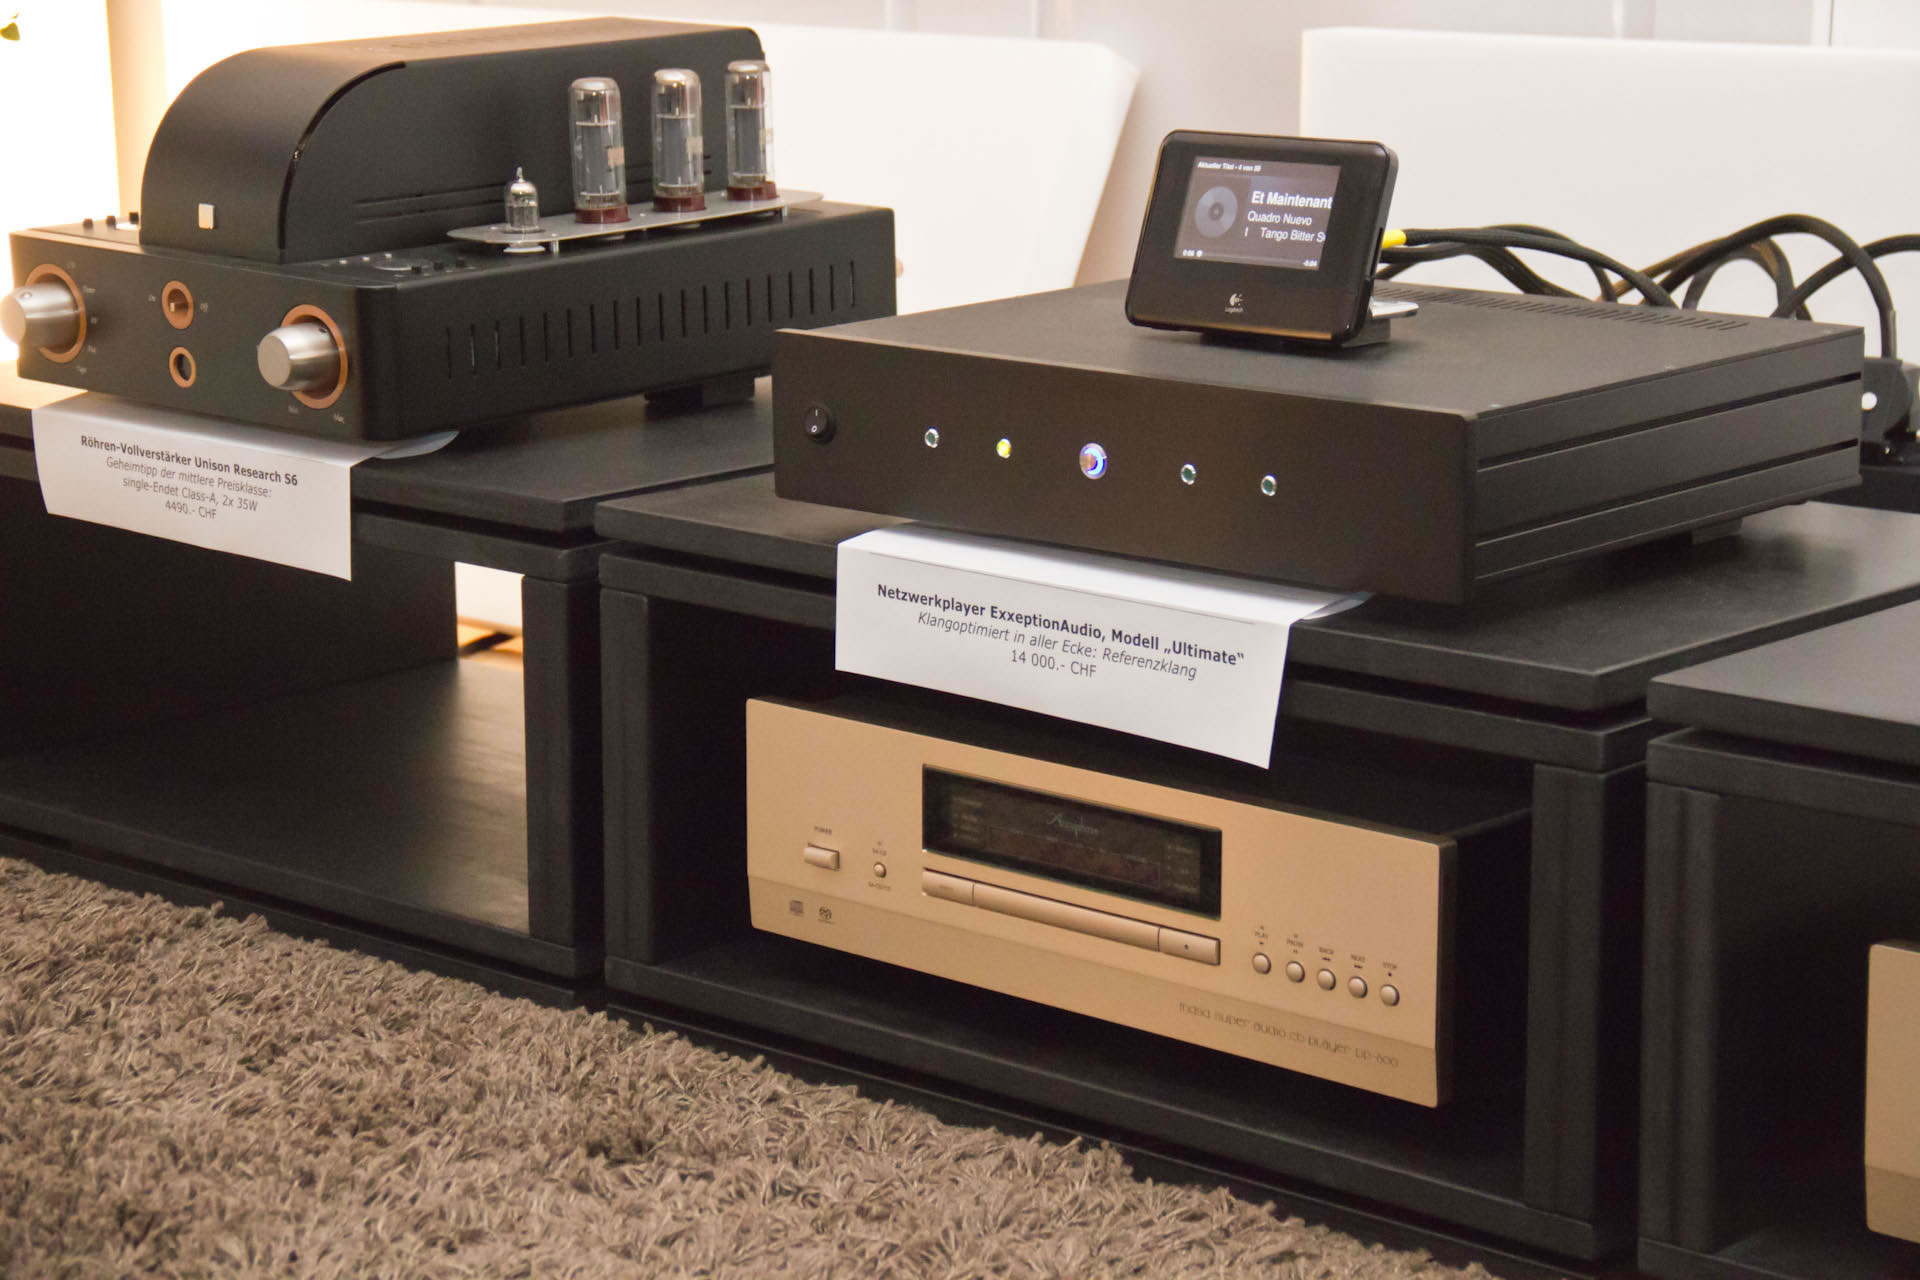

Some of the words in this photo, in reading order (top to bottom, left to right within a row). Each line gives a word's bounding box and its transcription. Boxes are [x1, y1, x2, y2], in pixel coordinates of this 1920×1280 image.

[1251, 190, 1265, 204] Et
[1266, 191, 1333, 209] Maintenant
[1247, 210, 1281, 224] Quadro
[1283, 213, 1312, 226] Nuevo
[1260, 226, 1289, 242] Tango
[1290, 228, 1315, 242] Bitter
[80, 435, 192, 466] Röhren-Vollverstärker
[194, 456, 231, 473] Unison
[233, 463, 282, 483] Research
[284, 472, 298, 486] S6
[106, 456, 158, 478] Geheimtipp
[160, 467, 176, 479] der
[178, 472, 215, 487] mittlere
[217, 477, 272, 498] Preisklasse:
[122, 477, 179, 497] single-Endet
[182, 487, 219, 506] Class-A,
[222, 494, 234, 507] 2x
[236, 497, 258, 512] 35W
[165, 500, 196, 515] 4490.-
[198, 506, 217, 519] CHF
[877, 584, 986, 616] Netzwerkplayer
[990, 605, 1106, 643] ExxeptionAudio,
[1111, 628, 1159, 651] Modell
[917, 611, 1010, 642] Klangoptimiert
[1013, 631, 1025, 644] in
[1029, 634, 1059, 651] aller
[1061, 639, 1098, 658] Ecke:
[1102, 647, 1198, 681] Referenzklang
[1011, 650, 1027, 664] 14
[1031, 652, 1065, 671] 000.-
[1070, 660, 1097, 678] CHF
[1253, 1021, 1287, 1038] audio
